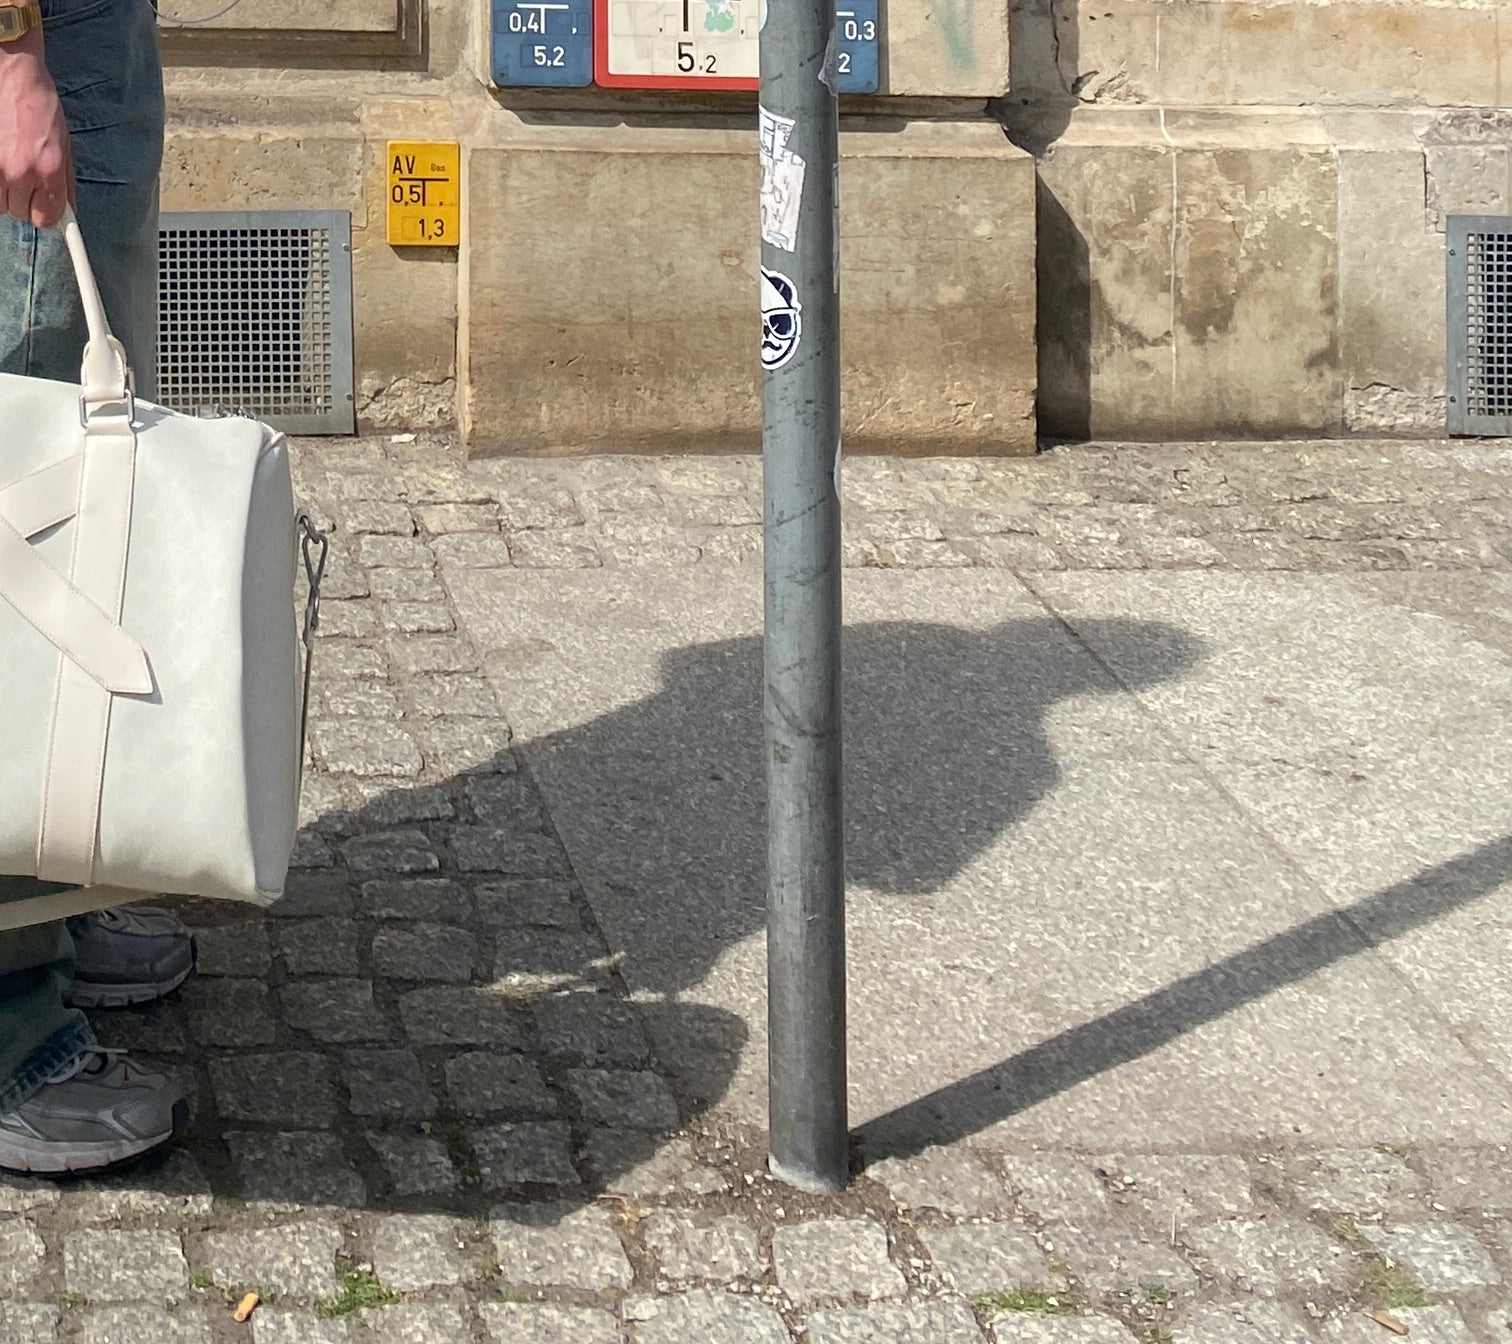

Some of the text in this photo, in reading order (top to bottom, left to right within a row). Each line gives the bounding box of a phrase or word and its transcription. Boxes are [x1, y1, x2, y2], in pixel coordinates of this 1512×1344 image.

[845, 20, 876, 41] 0,3
[534, 45, 565, 67] 5,2
[677, 41, 717, 74] 5,2
[418, 218, 445, 241] 1,3
